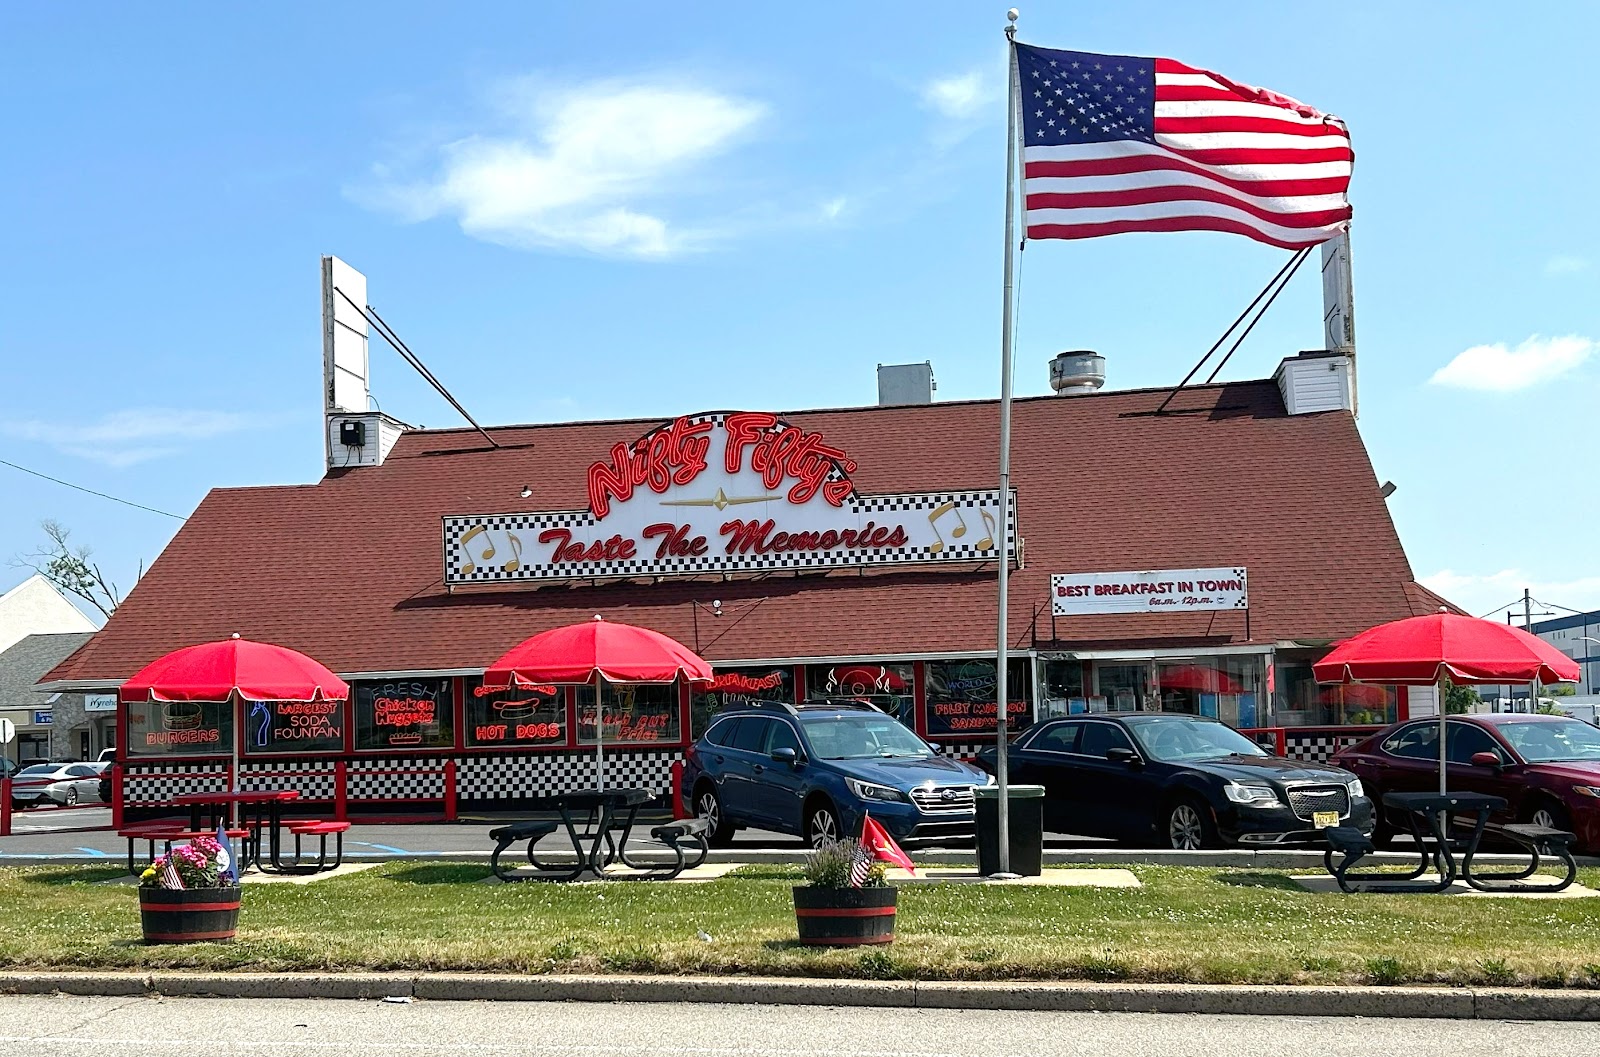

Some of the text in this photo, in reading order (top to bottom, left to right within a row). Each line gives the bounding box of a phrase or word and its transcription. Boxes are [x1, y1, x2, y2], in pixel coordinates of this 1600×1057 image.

[587, 412, 858, 520] Nifty Fifty's
[538, 518, 909, 564] Taste The Memories
[1057, 579, 1242, 597] BEST BREAKFAST IN TOWN
[371, 681, 438, 700] FRESH
[277, 703, 337, 715] LARGEST
[374, 697, 435, 712] Chicken
[934, 701, 1027, 715] FILET MIGON
[290, 715, 331, 727] SODA
[375, 710, 434, 727] Nuggets
[146, 728, 219, 745] BURGERS
[274, 726, 341, 740] FOUNTAIN
[476, 722, 560, 740] HOT DOGS
[616, 726, 658, 741] Fries
